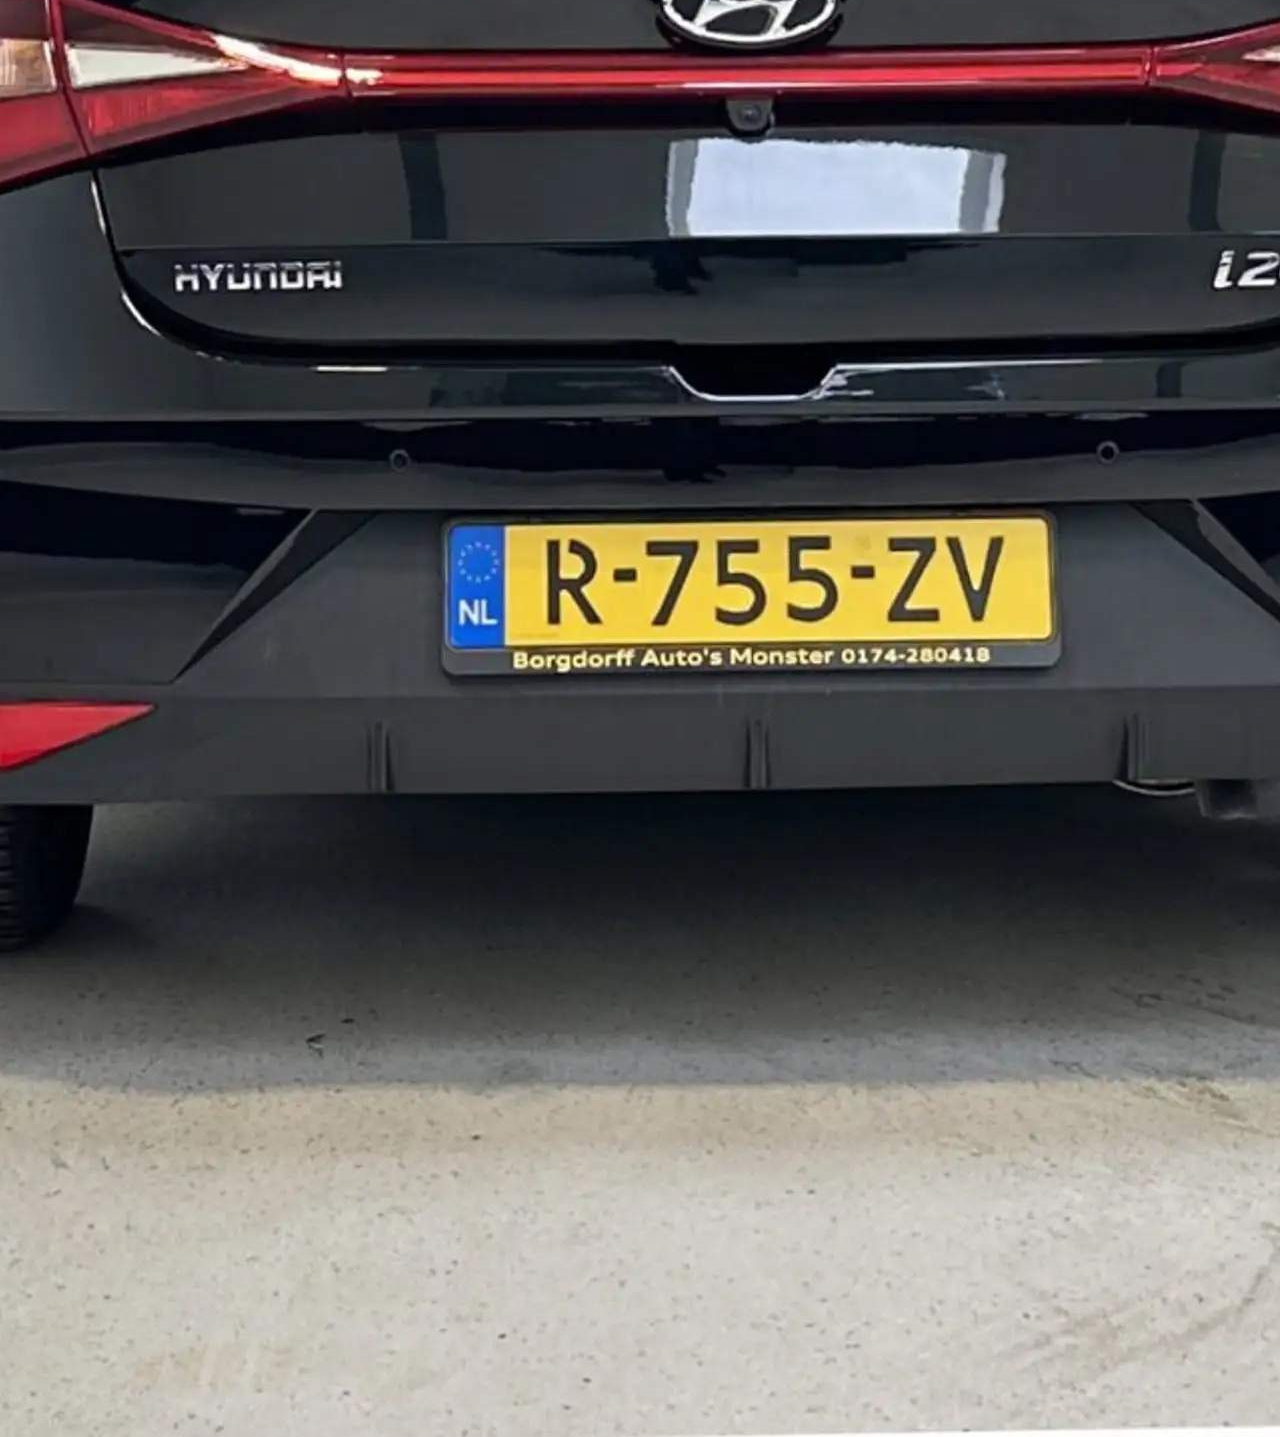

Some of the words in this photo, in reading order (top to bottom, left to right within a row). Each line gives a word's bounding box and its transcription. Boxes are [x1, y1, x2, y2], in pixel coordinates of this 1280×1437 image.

[174, 260, 343, 292] HYUNDAI
[546, 536, 1004, 626] R-755-ZV
[458, 599, 498, 626] NL
[512, 649, 635, 673] Borgdorff
[640, 647, 723, 667] Auto's
[729, 646, 834, 666] Monster
[840, 646, 991, 664] 0174-280418
